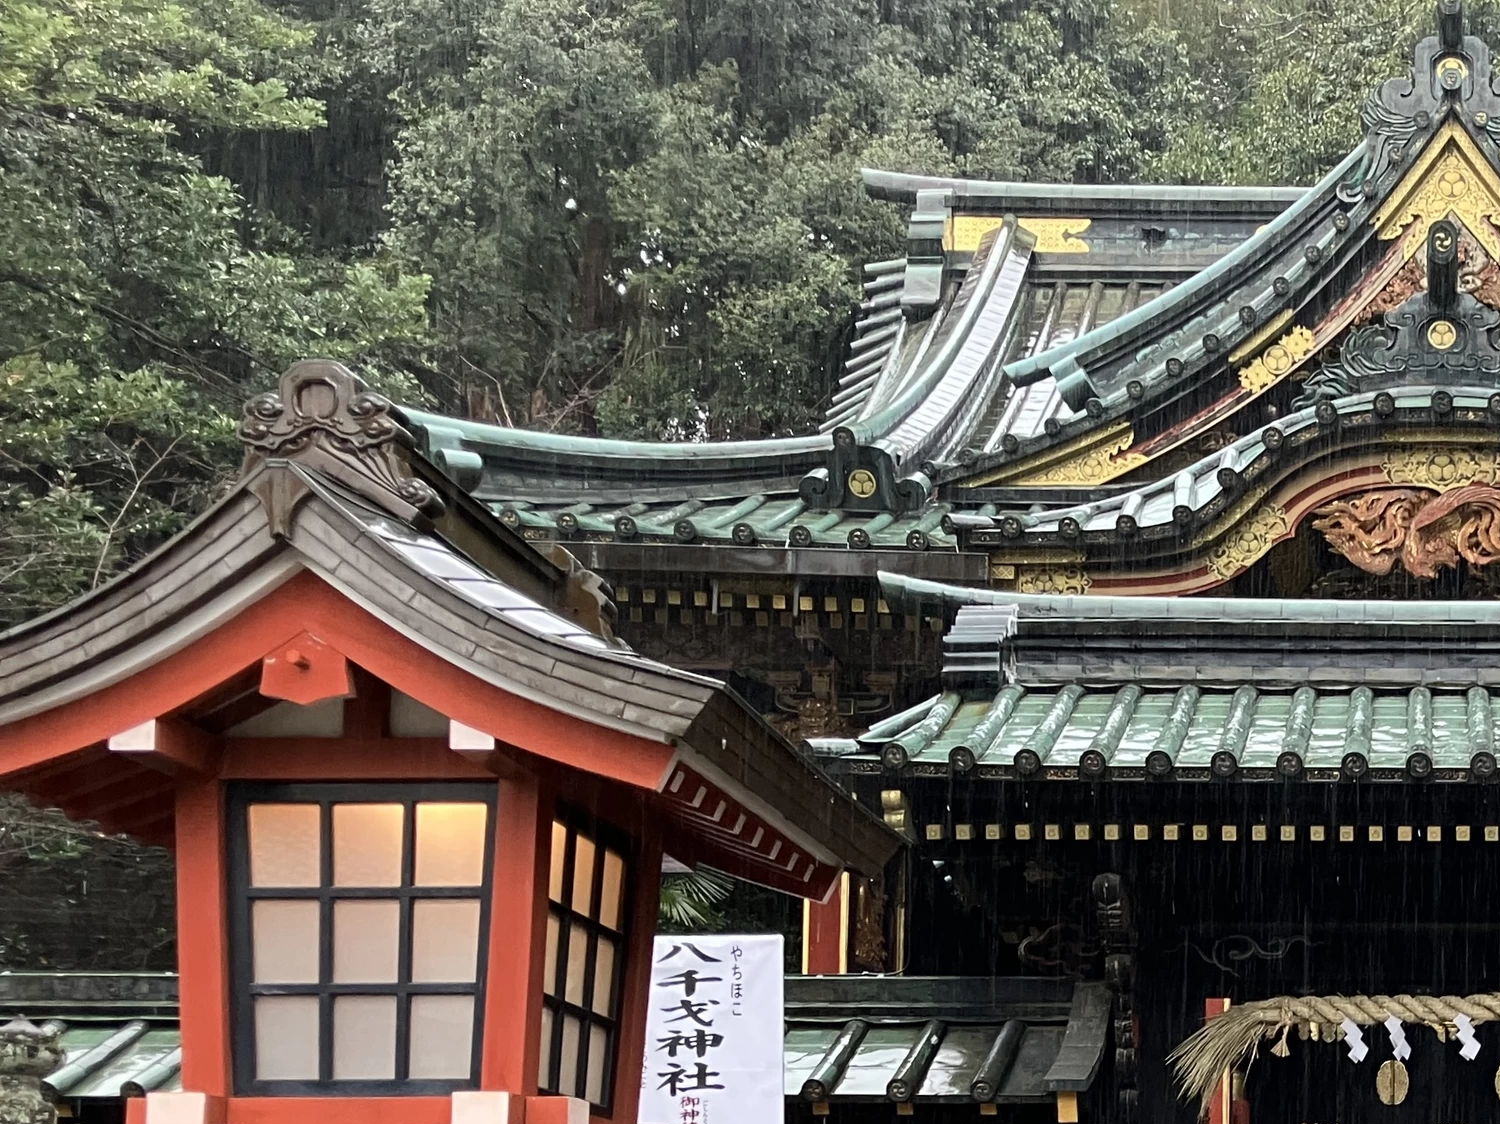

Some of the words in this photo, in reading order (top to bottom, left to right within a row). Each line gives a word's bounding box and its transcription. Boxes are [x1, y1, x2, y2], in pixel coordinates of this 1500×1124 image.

[655, 941, 725, 1096] 八千戈神社
[730, 944, 743, 1017] やちほこ
